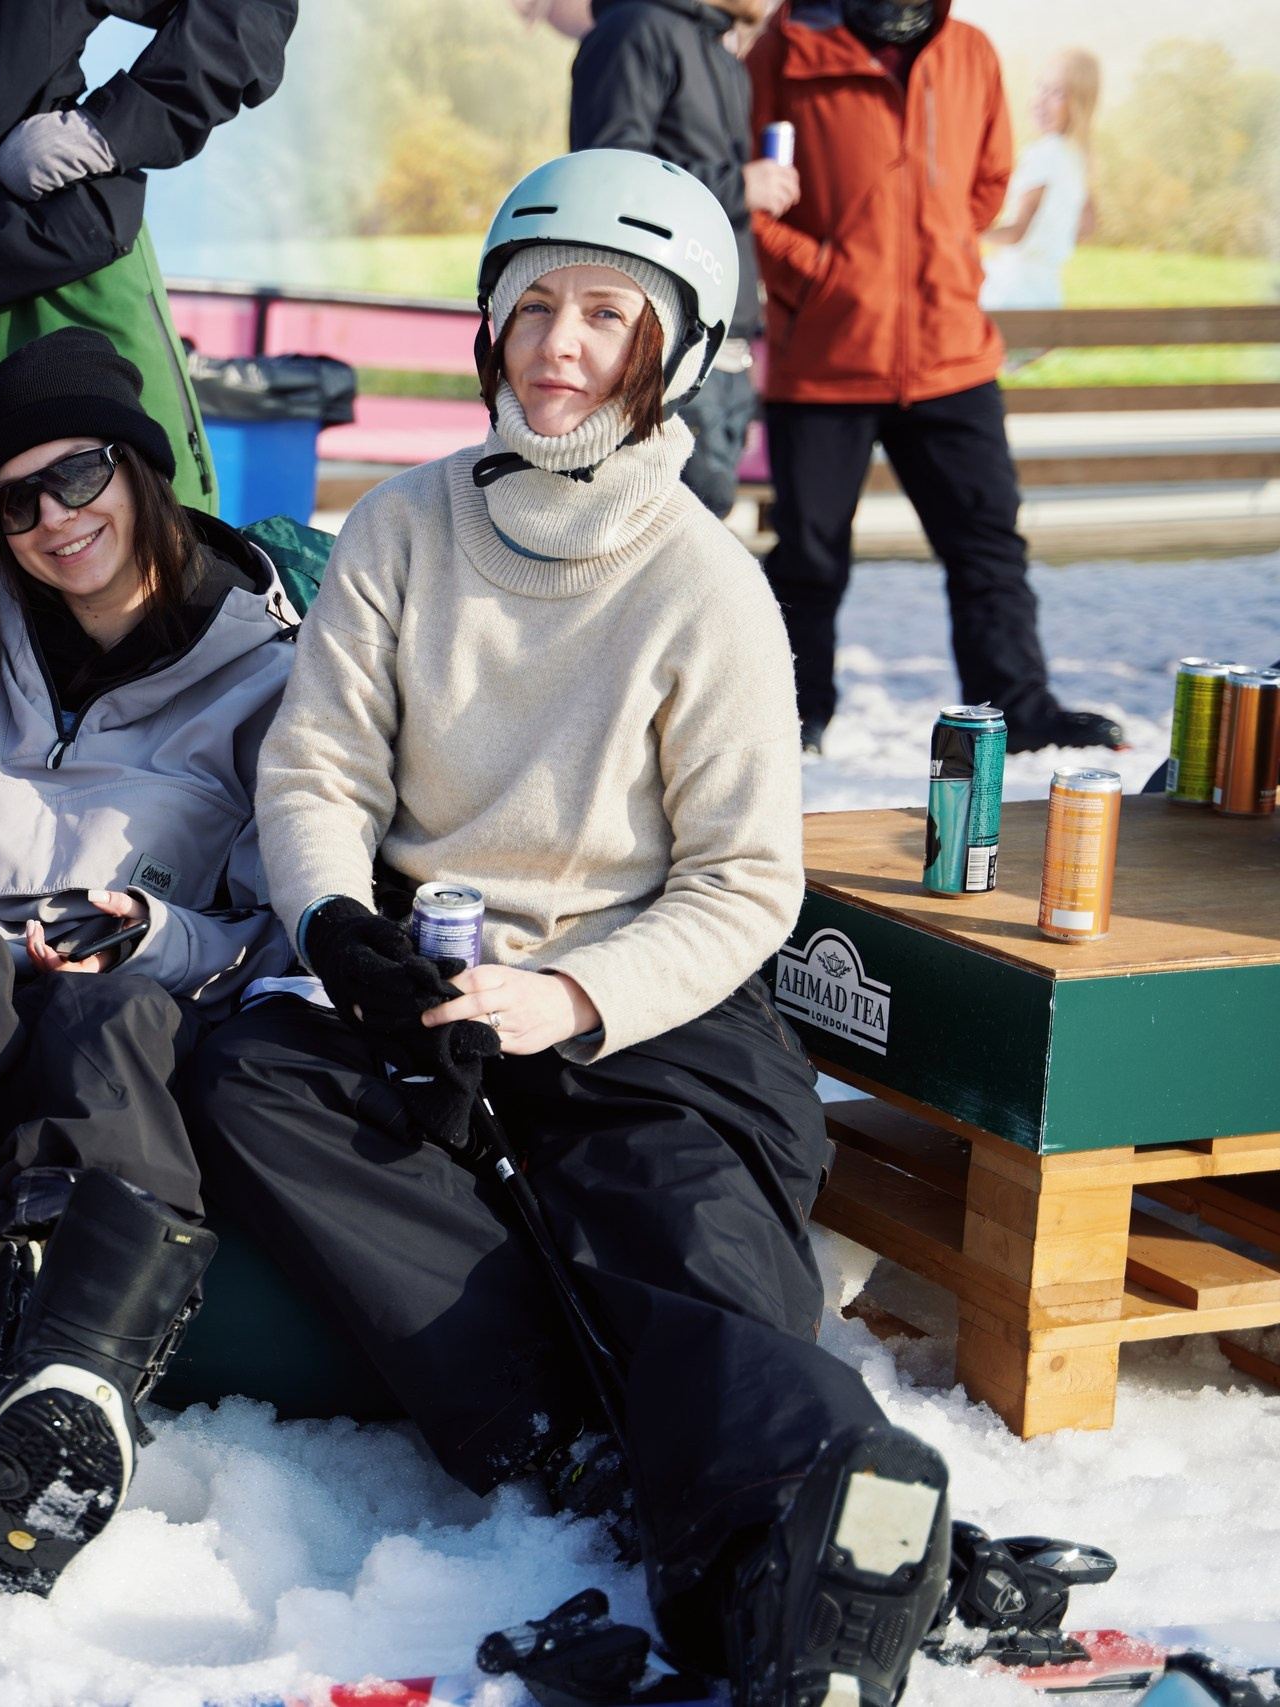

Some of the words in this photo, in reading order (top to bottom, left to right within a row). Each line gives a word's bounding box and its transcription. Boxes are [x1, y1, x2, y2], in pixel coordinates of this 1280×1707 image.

[778, 964, 848, 1014] AHMAD
[851, 991, 886, 1032] TEA
[811, 1010, 849, 1034] LONDON
